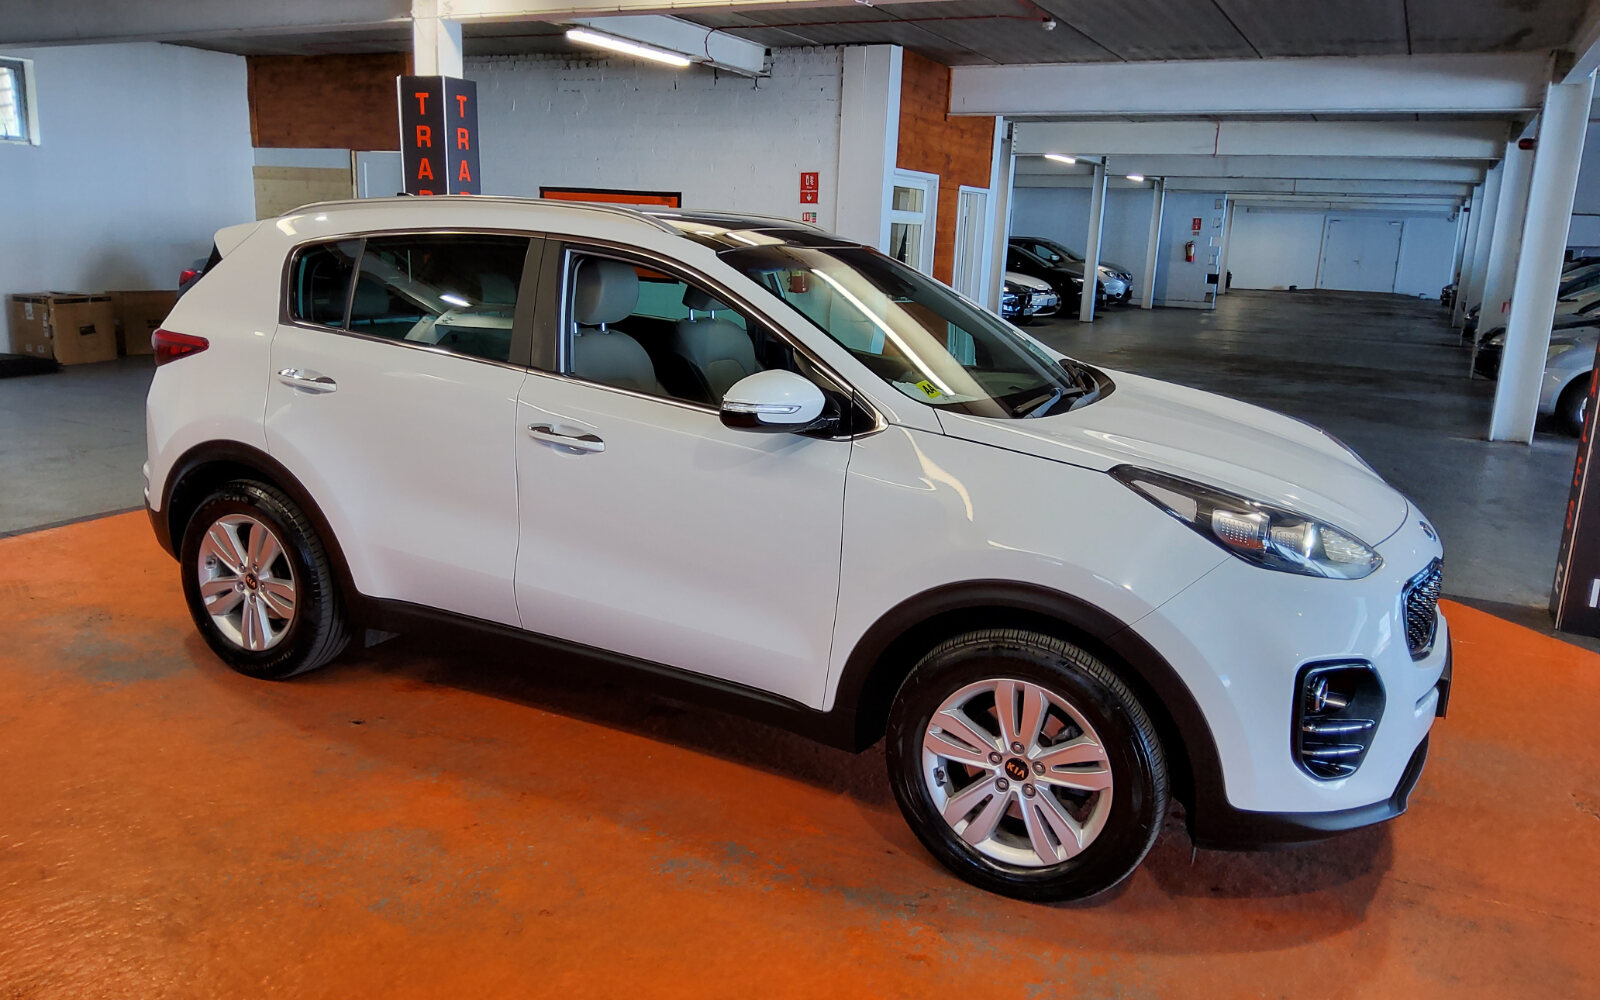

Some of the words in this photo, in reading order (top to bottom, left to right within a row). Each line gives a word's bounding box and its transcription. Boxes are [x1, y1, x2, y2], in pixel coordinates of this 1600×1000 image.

[414, 92, 434, 196] TRA
[456, 95, 471, 196] TRA
[1007, 762, 1025, 778] KIA
